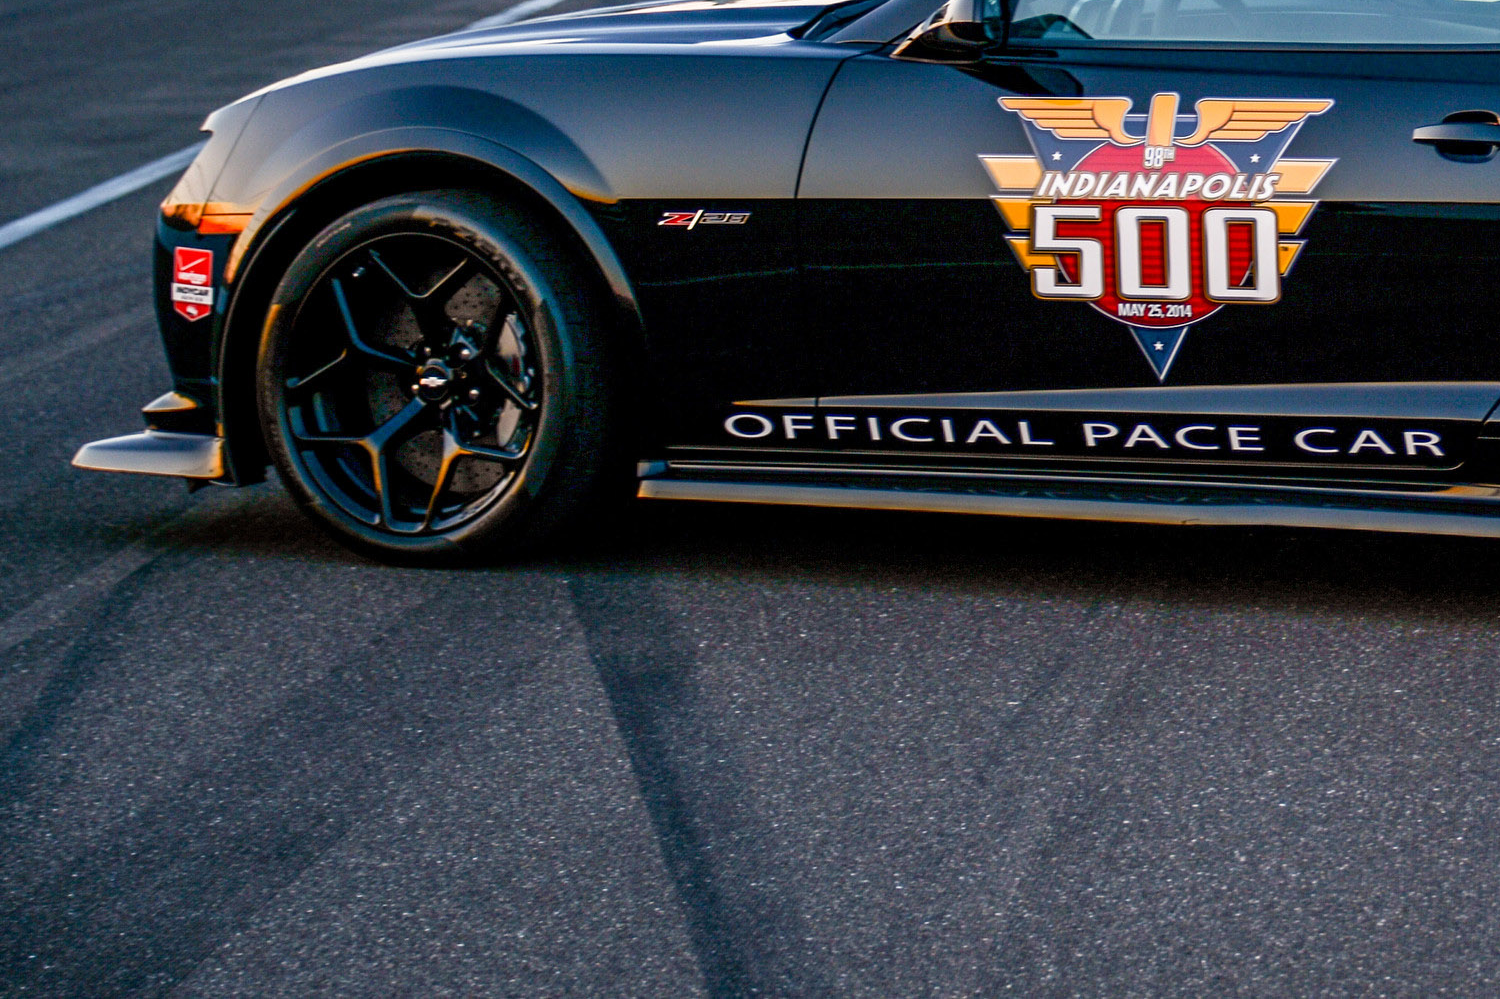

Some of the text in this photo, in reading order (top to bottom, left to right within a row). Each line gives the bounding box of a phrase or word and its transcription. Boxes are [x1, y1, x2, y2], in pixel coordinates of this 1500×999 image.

[1036, 171, 1281, 201] INDIANAPOLIS
[1030, 204, 1281, 303] 500
[1118, 303, 1193, 318] MAY 25, 2014
[724, 413, 1445, 457] OFFICIAL PACE CAR
